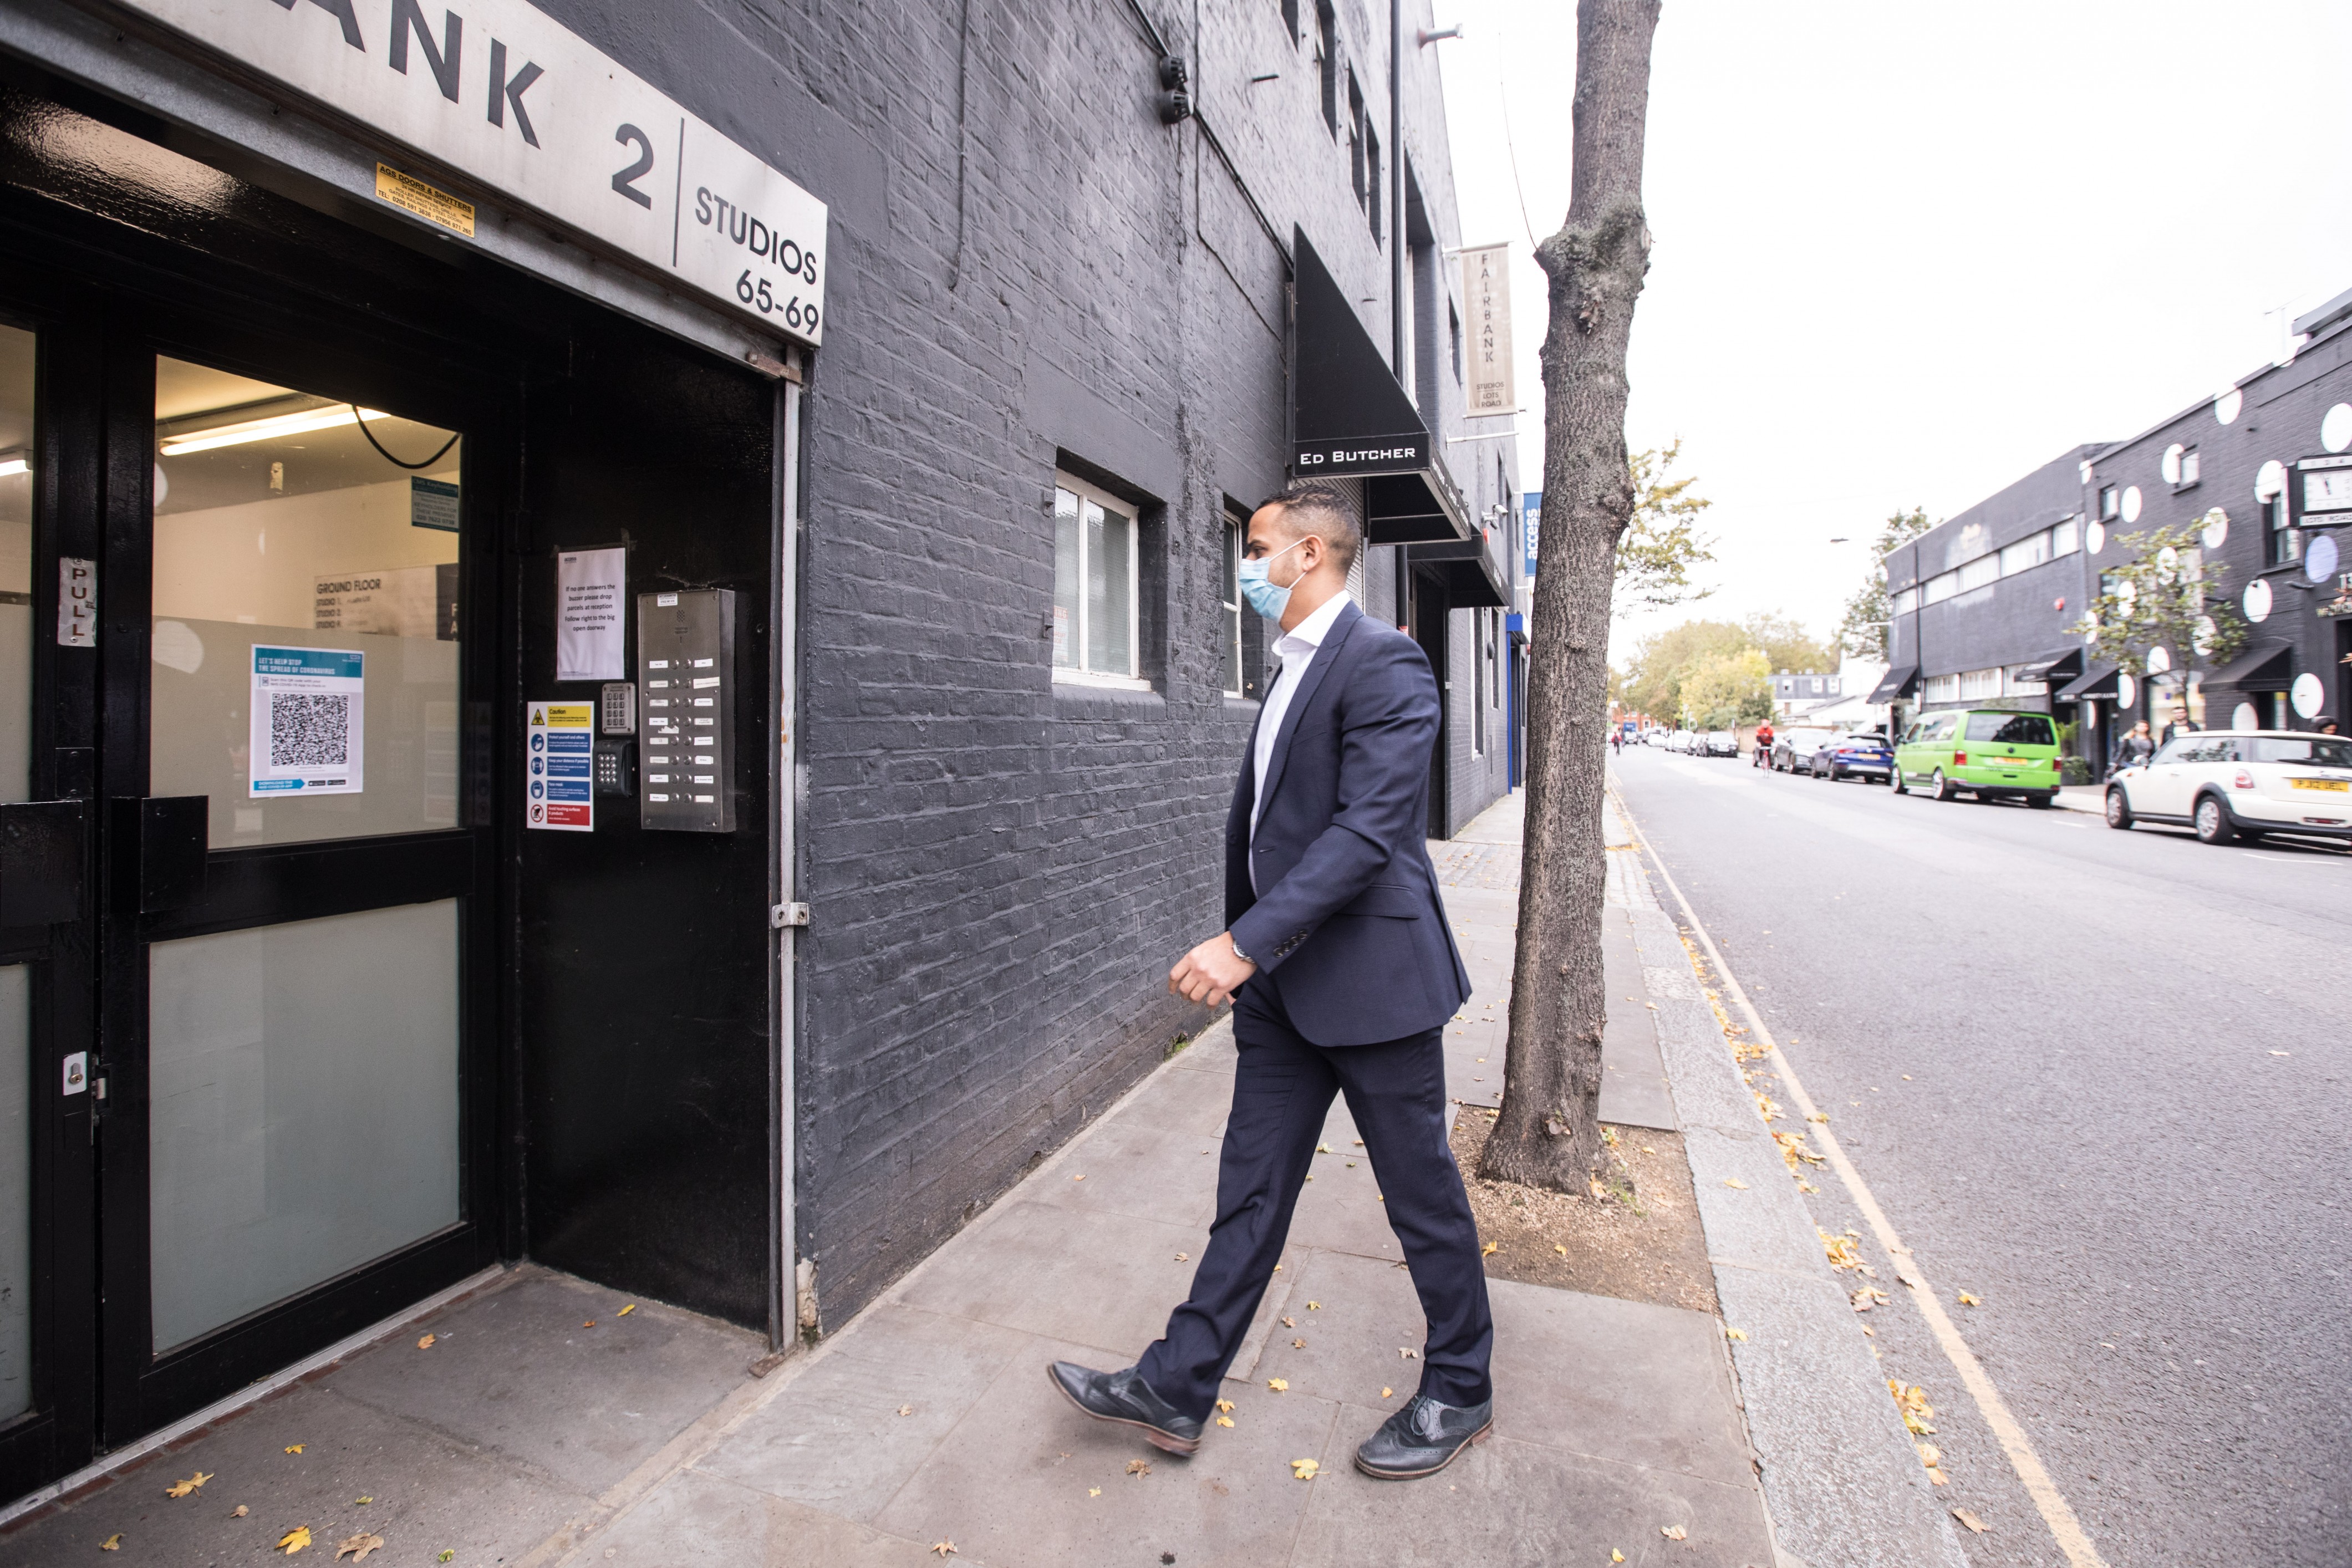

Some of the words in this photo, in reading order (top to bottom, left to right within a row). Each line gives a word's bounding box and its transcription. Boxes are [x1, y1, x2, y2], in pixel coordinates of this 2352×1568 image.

[272, 0, 544, 150] NK
[612, 123, 654, 210] 2
[378, 189, 390, 200] TEL:
[392, 196, 406, 207] 0208
[407, 202, 416, 211] 591
[419, 207, 431, 218] 3636
[435, 215, 451, 226] 07956
[452, 222, 461, 231] 971
[379, 166, 397, 178] AGS
[399, 174, 425, 191] DOORS
[434, 190, 472, 212] SHUTTERS
[395, 186, 414, 198] ROLLER
[406, 196, 427, 210] RAILINGS
[432, 207, 446, 218] STEEL
[416, 190, 432, 201] REPAIR
[433, 197, 451, 210] SERVICE
[695, 186, 817, 285] STUDIOS
[736, 269, 819, 335] 65-69
[1481, 253, 1493, 363] FAIRBANK
[1477, 381, 1505, 390] STUDIOS
[1481, 400, 1501, 408] ROAD
[1526, 508, 1539, 560] access
[71, 568, 87, 637] PULL
[317, 582, 352, 594] GROUND
[354, 578, 381, 590] FLOOR
